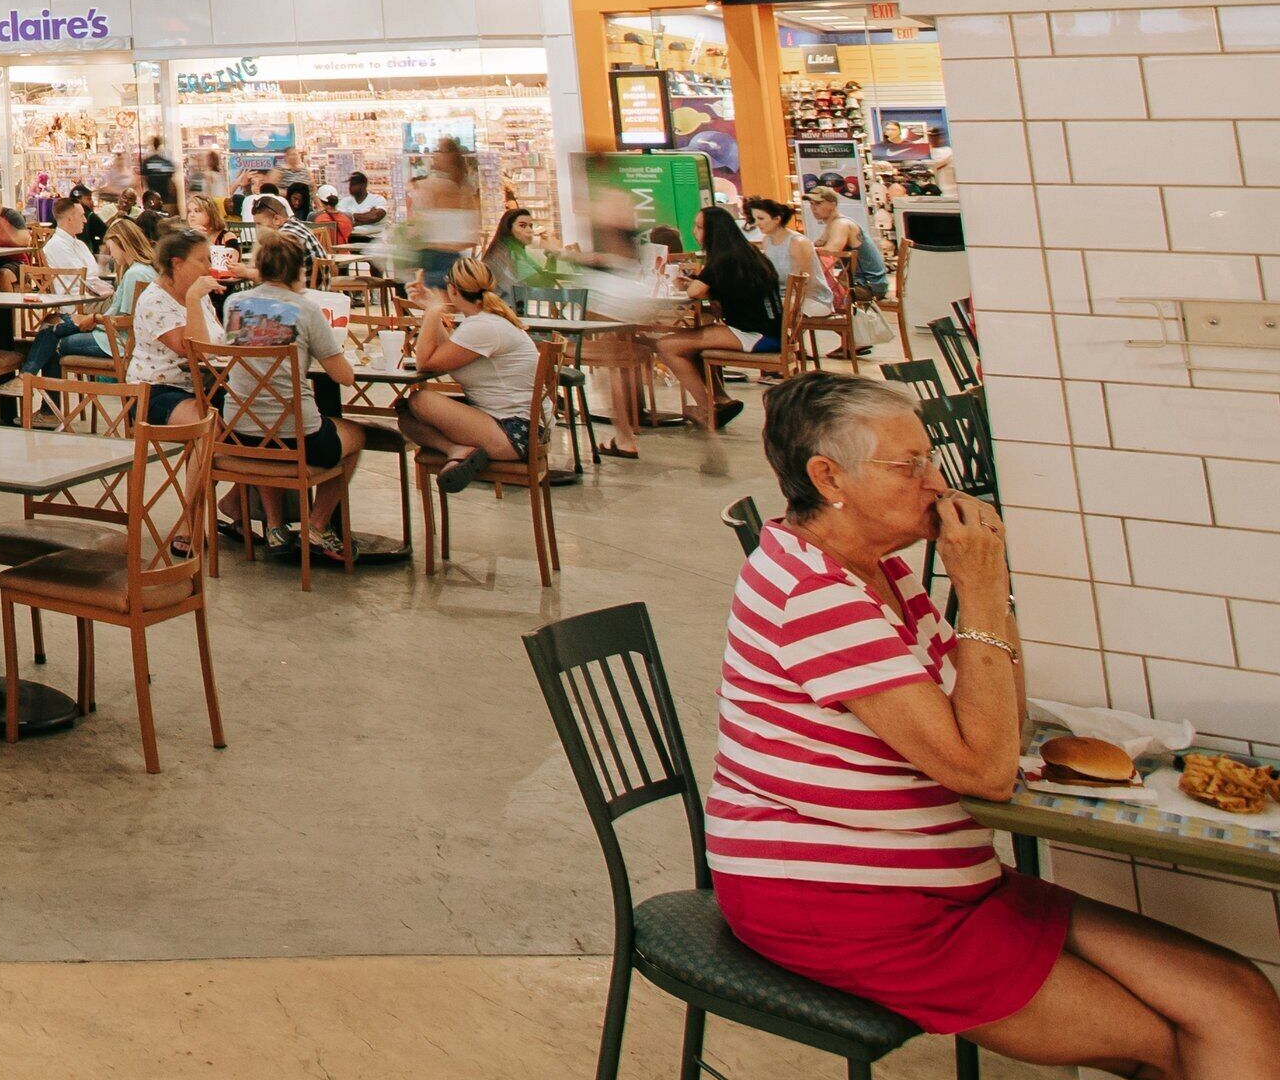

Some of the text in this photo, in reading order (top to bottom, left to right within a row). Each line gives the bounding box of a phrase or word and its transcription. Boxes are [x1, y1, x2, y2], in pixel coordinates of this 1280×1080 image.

[872, 3, 895, 19] EXIT
[897, 28, 914, 40] EXIT
[807, 54, 835, 65] Lids
[314, 62, 365, 71] welcome
[370, 61, 381, 69] to
[619, 166, 663, 174] Instant Cash
